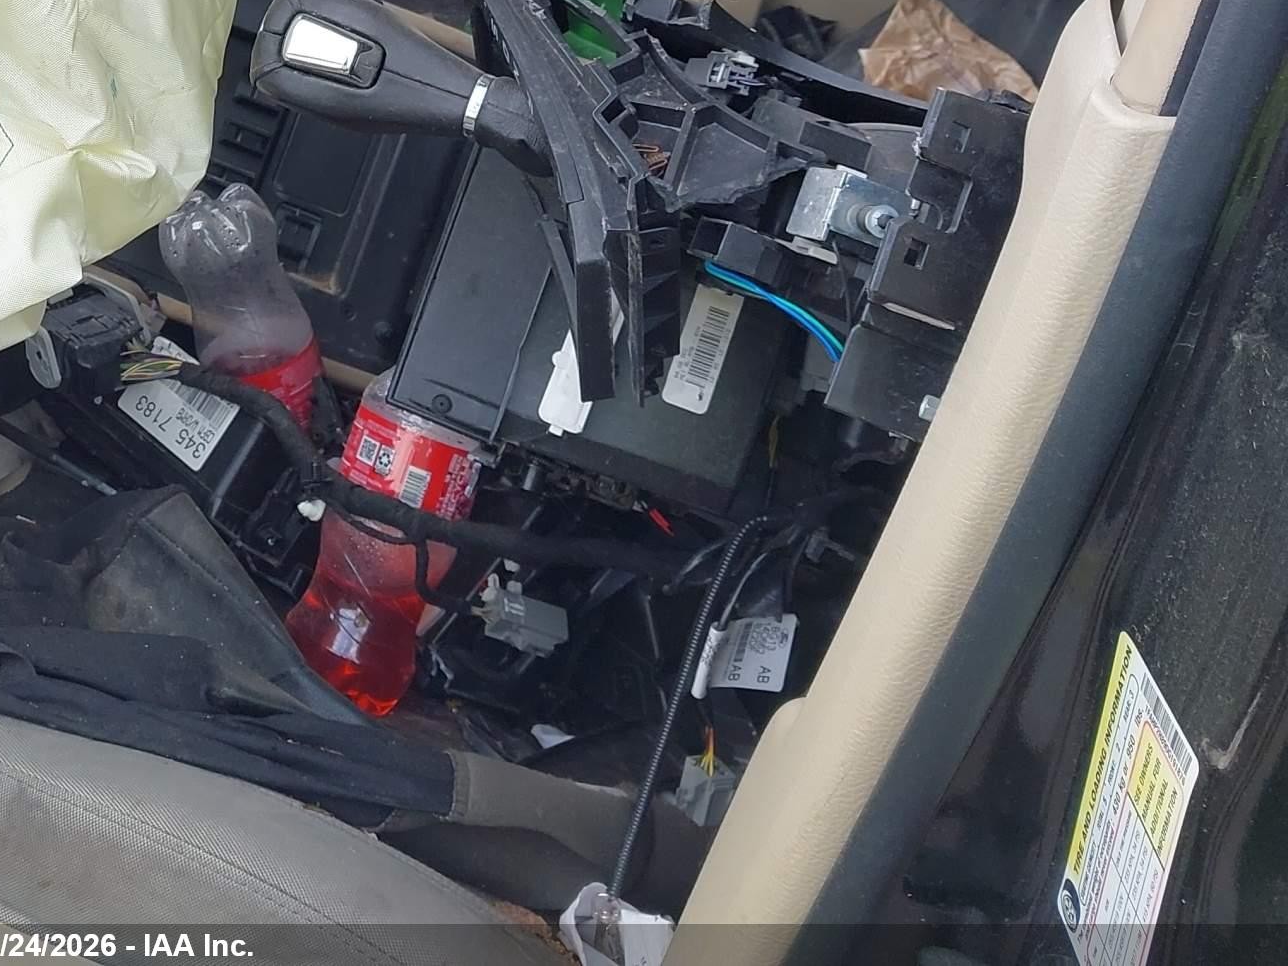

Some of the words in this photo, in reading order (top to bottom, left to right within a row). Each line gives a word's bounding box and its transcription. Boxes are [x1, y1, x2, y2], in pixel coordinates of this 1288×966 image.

[135, 395, 173, 432] 7183
[175, 429, 206, 459] 345
[727, 664, 742, 681] AB
[756, 665, 772, 684] AB
[1074, 842, 1084, 875] TIRE
[1082, 811, 1091, 842] AND
[1089, 748, 1107, 810] LOADING
[1104, 645, 1132, 746] INFORMATION
[1112, 792, 1121, 817] 430
[1118, 775, 1126, 794] kg
[1123, 763, 1128, 776] or
[1126, 734, 1135, 760] 950
[1139, 742, 1153, 787] OWNERS
[1142, 779, 1156, 824] MANUAL
[1152, 756, 1161, 781] FOR
[1149, 775, 1168, 839] ADDITIONAL
